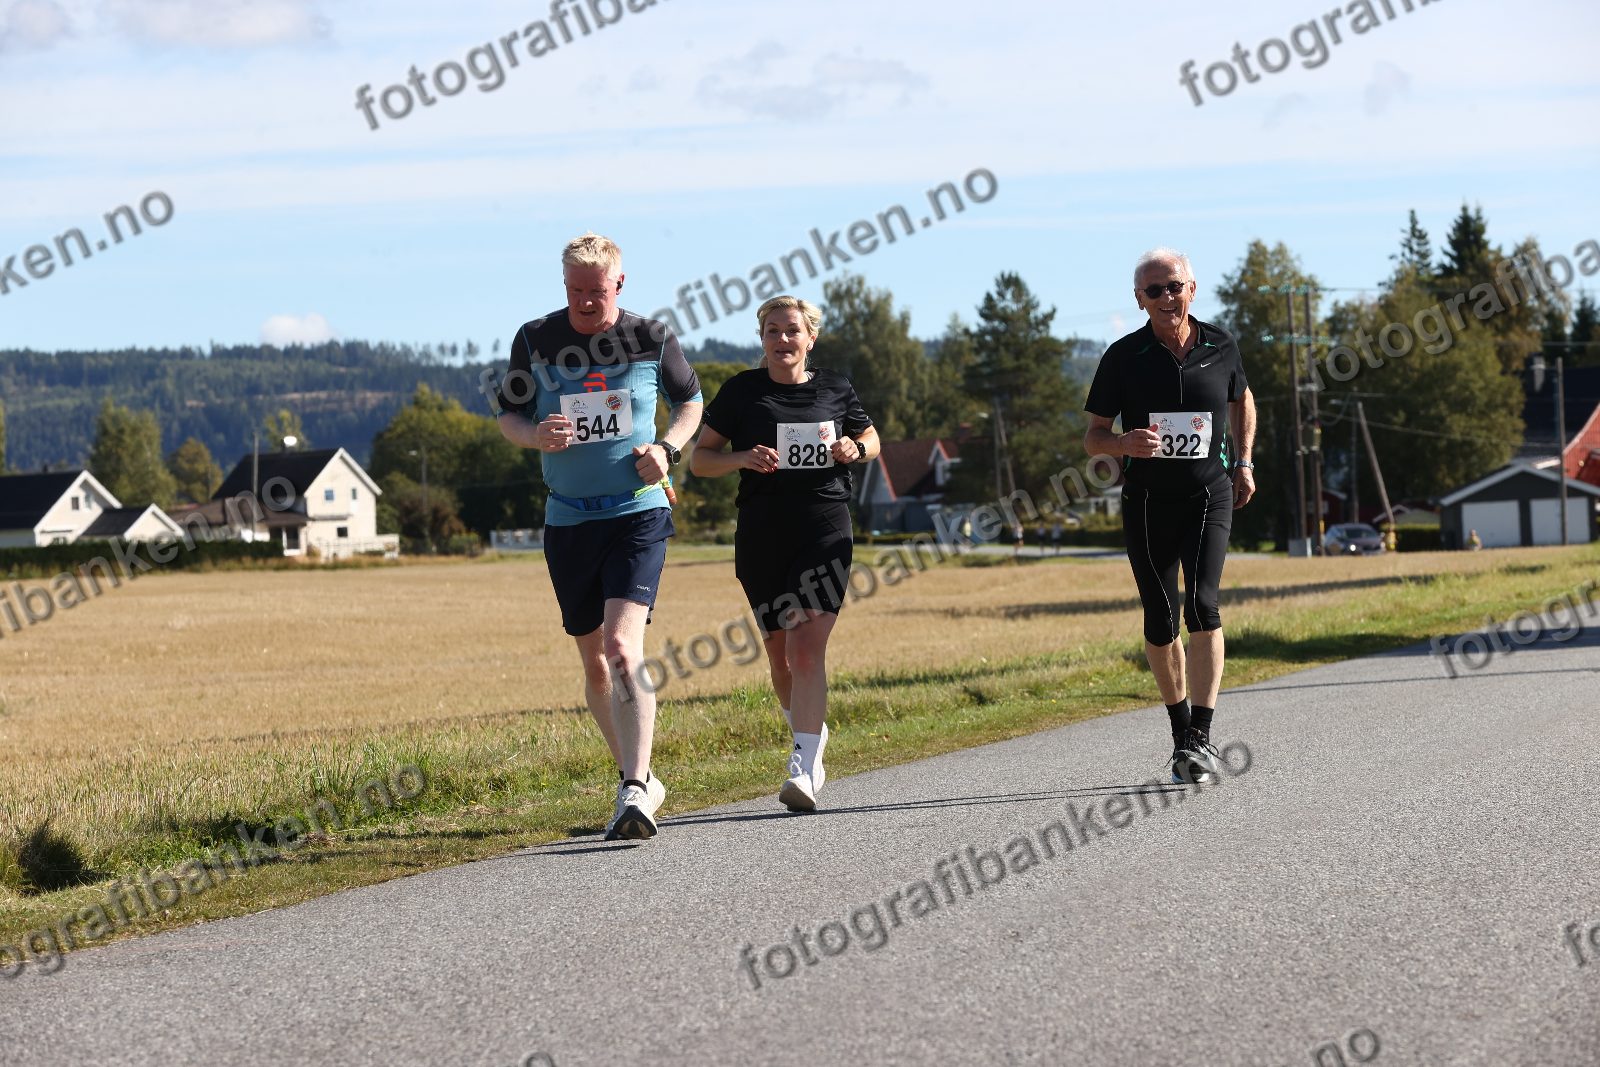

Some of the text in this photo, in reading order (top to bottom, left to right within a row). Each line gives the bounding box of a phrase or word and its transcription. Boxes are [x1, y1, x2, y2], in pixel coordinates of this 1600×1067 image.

[576, 413, 620, 441] 544
[788, 443, 828, 467] 828
[1161, 433, 1201, 457] 322
